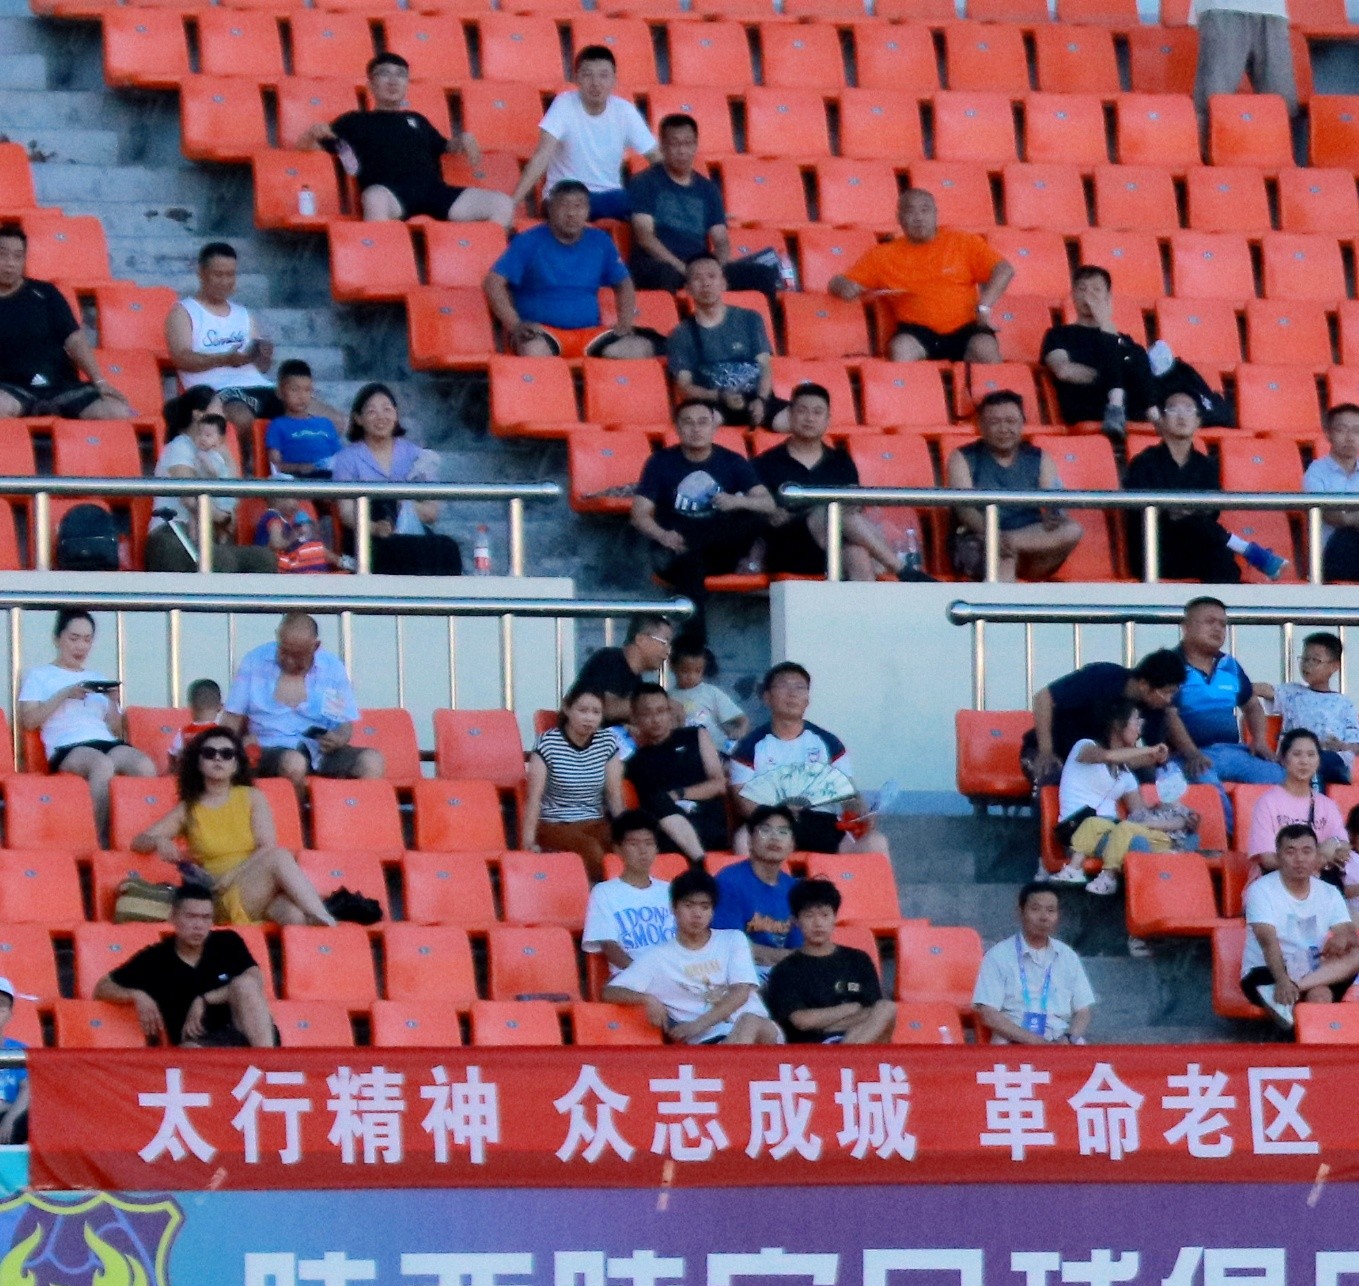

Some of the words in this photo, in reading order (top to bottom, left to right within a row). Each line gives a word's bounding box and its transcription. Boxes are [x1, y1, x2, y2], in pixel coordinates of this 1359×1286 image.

[138, 1067, 501, 1164] 太行精神
[554, 1064, 917, 1162] 众志成城
[977, 1062, 1322, 1162] 革命老区
